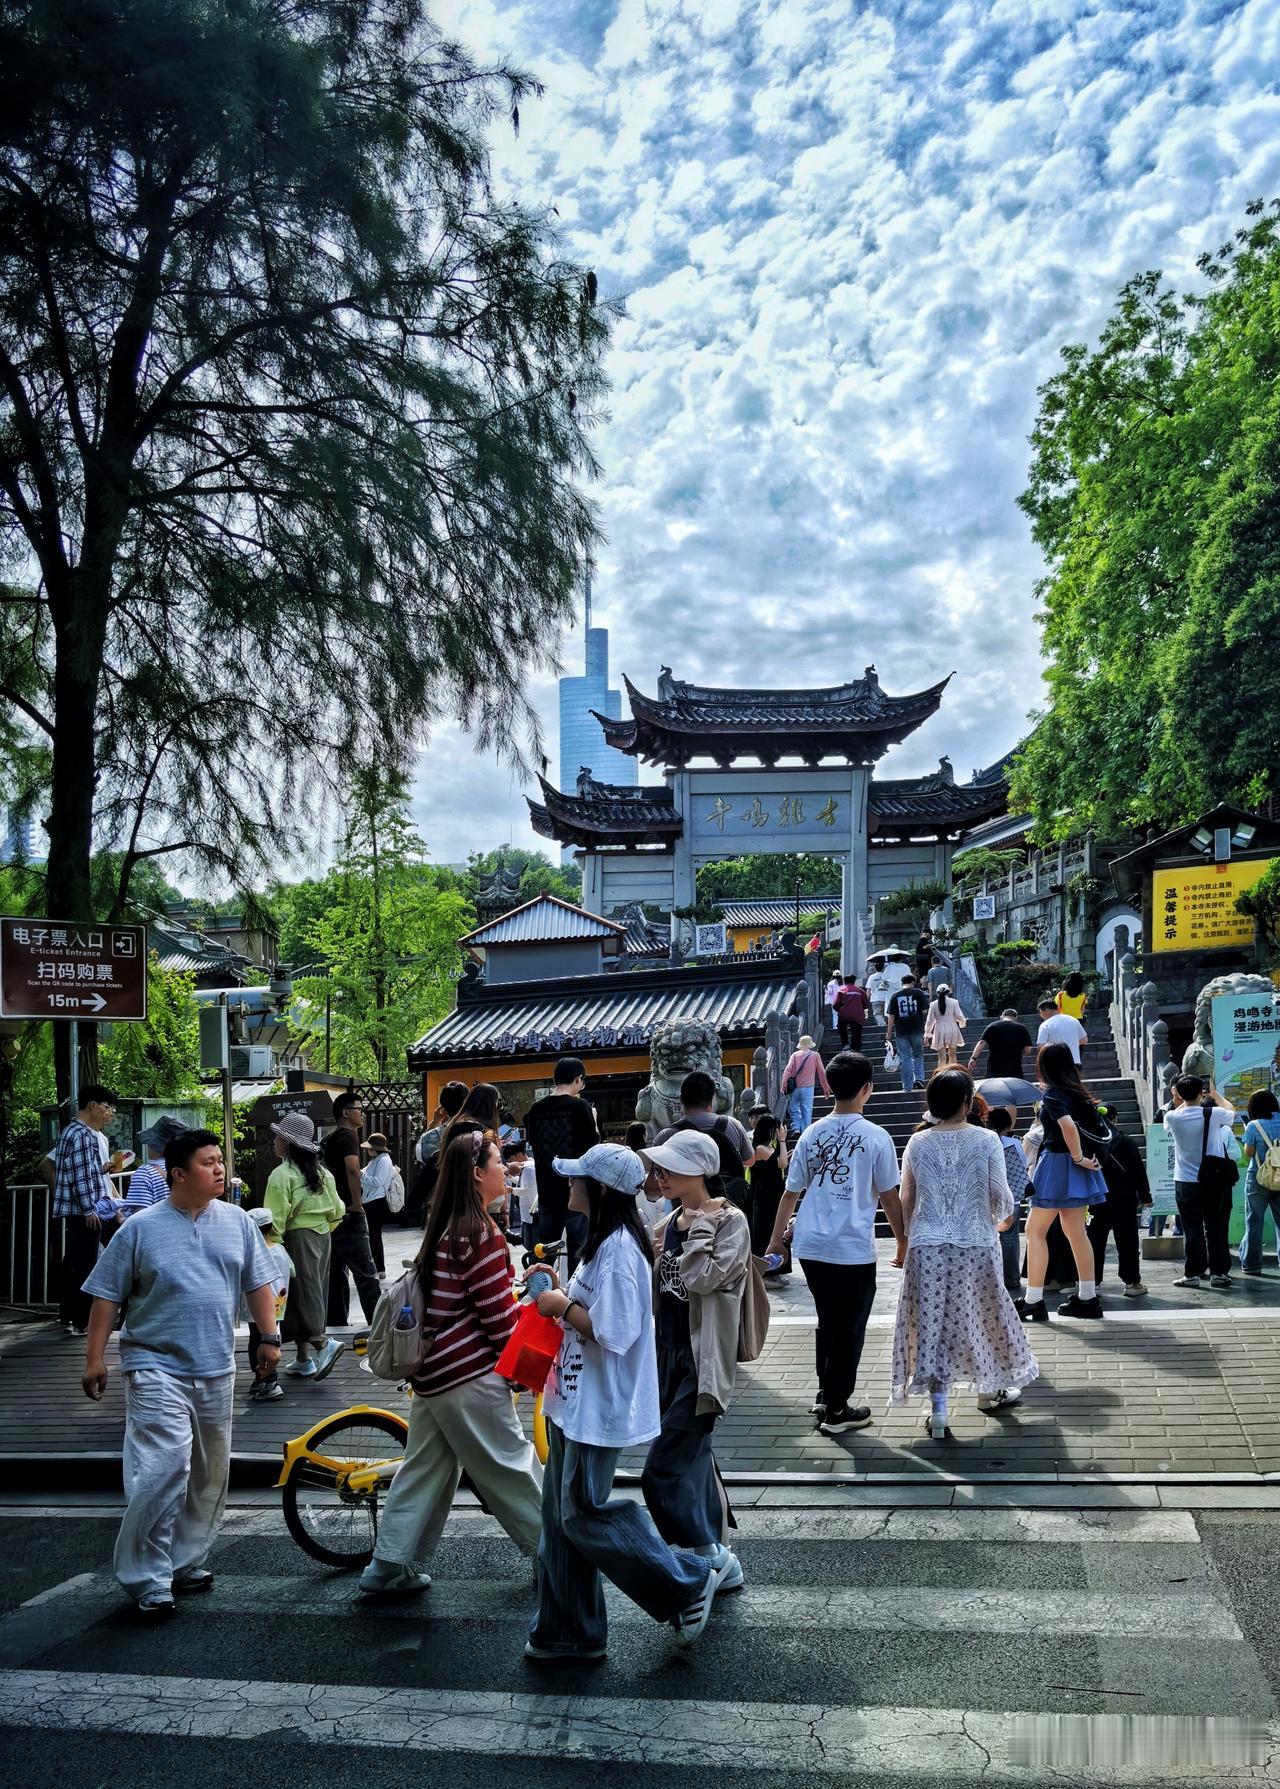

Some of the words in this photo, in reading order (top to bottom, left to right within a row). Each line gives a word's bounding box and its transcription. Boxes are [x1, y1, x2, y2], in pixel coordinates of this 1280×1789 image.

[1164, 888, 1178, 940] 温馨提示
[13, 927, 103, 949] 电子票入口
[30, 947, 63, 955] E-ticket
[65, 949, 101, 957] Entrance
[38, 961, 113, 980] 扫码购票
[48, 994, 79, 1007] 15m
[1233, 1006, 1273, 1018] 鸡鸣寺
[494, 1021, 668, 1053] 鸡鸣寺法物流
